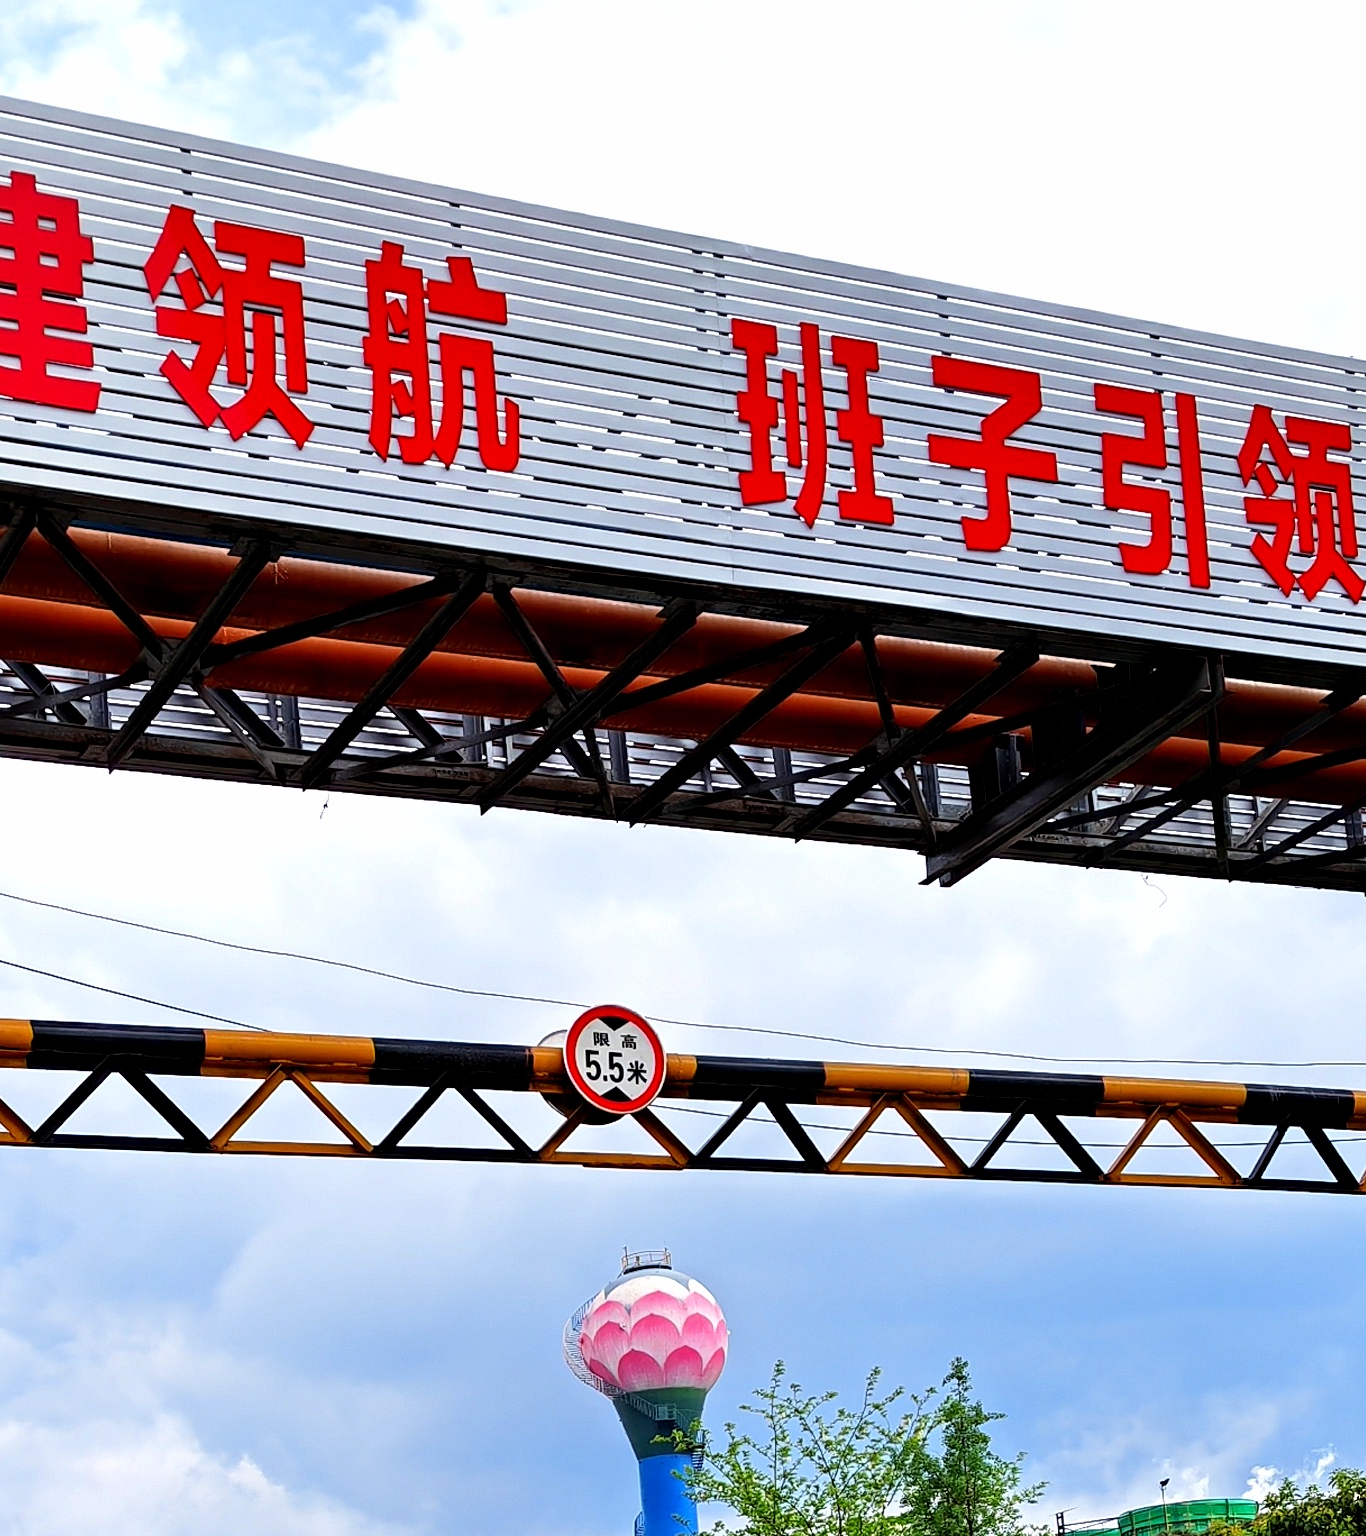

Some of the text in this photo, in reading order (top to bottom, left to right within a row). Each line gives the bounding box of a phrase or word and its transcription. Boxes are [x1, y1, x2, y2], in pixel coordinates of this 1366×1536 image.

[730, 319, 1366, 603] 班子引领
[592, 1031, 638, 1050] 限高
[585, 1049, 648, 1085] 5.5米
